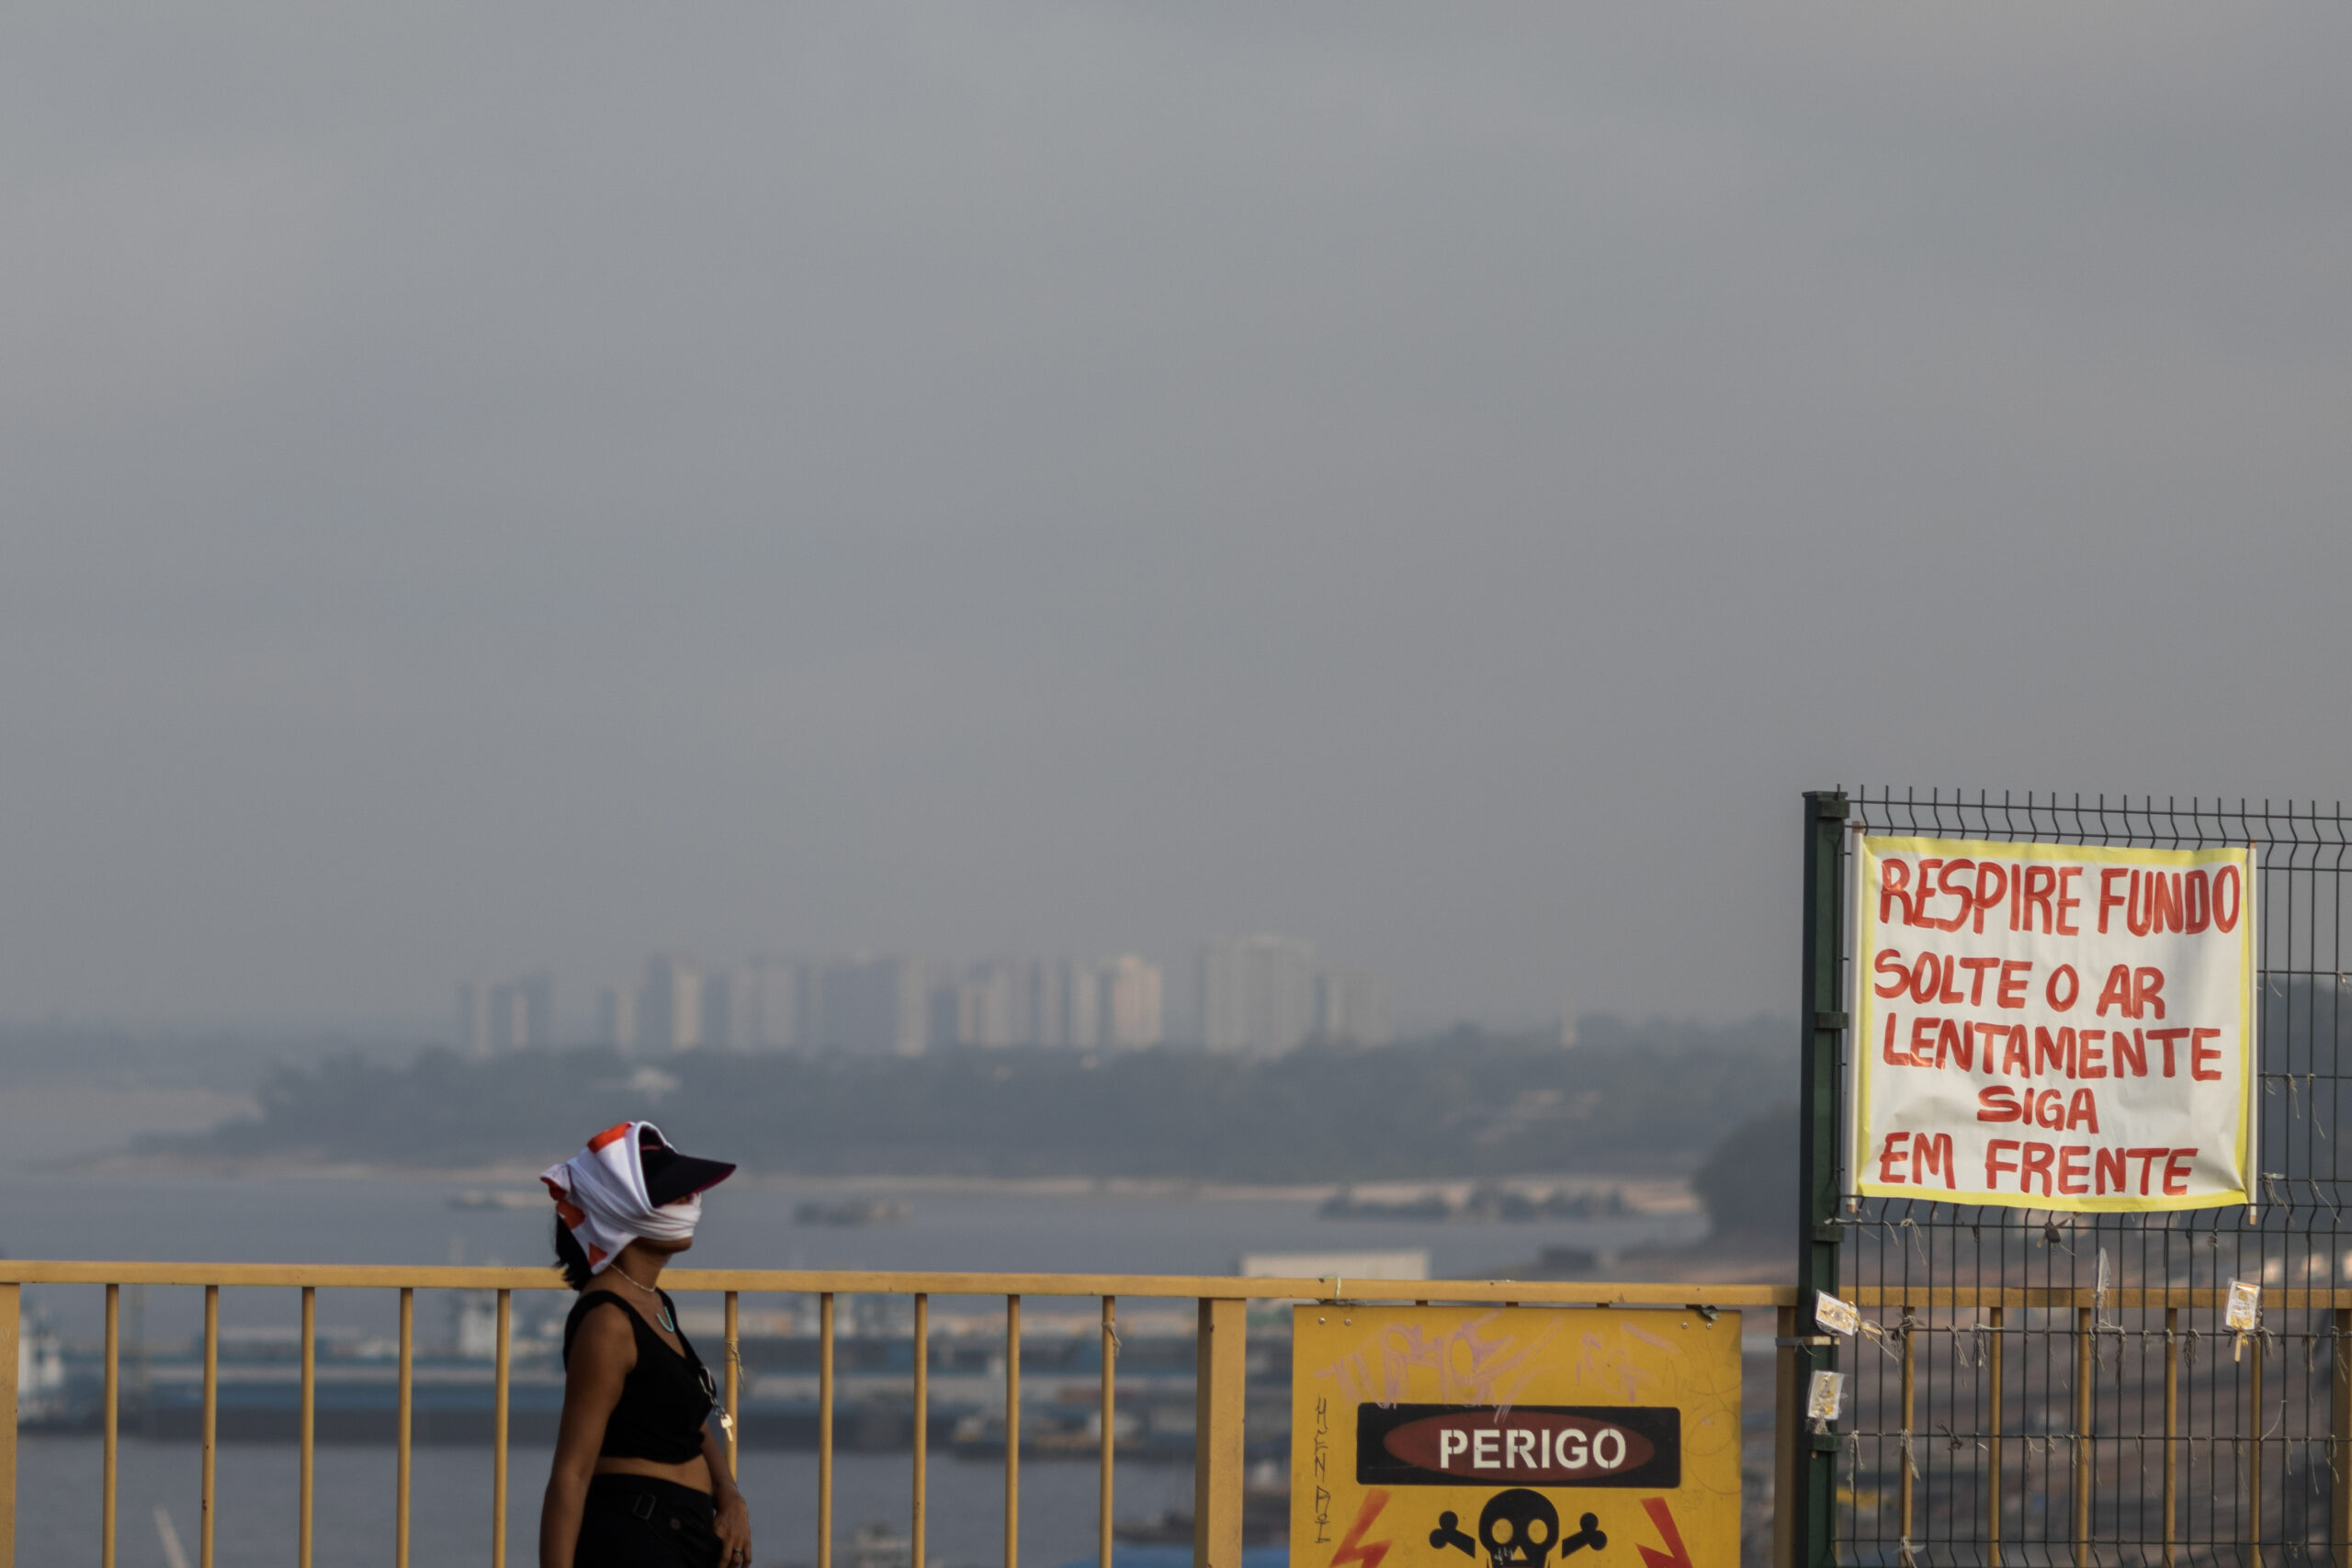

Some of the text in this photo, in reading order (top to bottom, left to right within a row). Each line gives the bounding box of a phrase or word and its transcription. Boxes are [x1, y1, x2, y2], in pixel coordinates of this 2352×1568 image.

[1879, 857, 2241, 938] RESPIRE FUNDO
[1873, 948, 2165, 1021] SOLTE O AR
[1883, 1011, 2222, 1081] LENTAMENTE
[1976, 1085, 2100, 1135] SIGA
[1879, 1131, 2199, 1199] EM FRENTE
[1439, 1428, 1627, 1470] PERIGO
